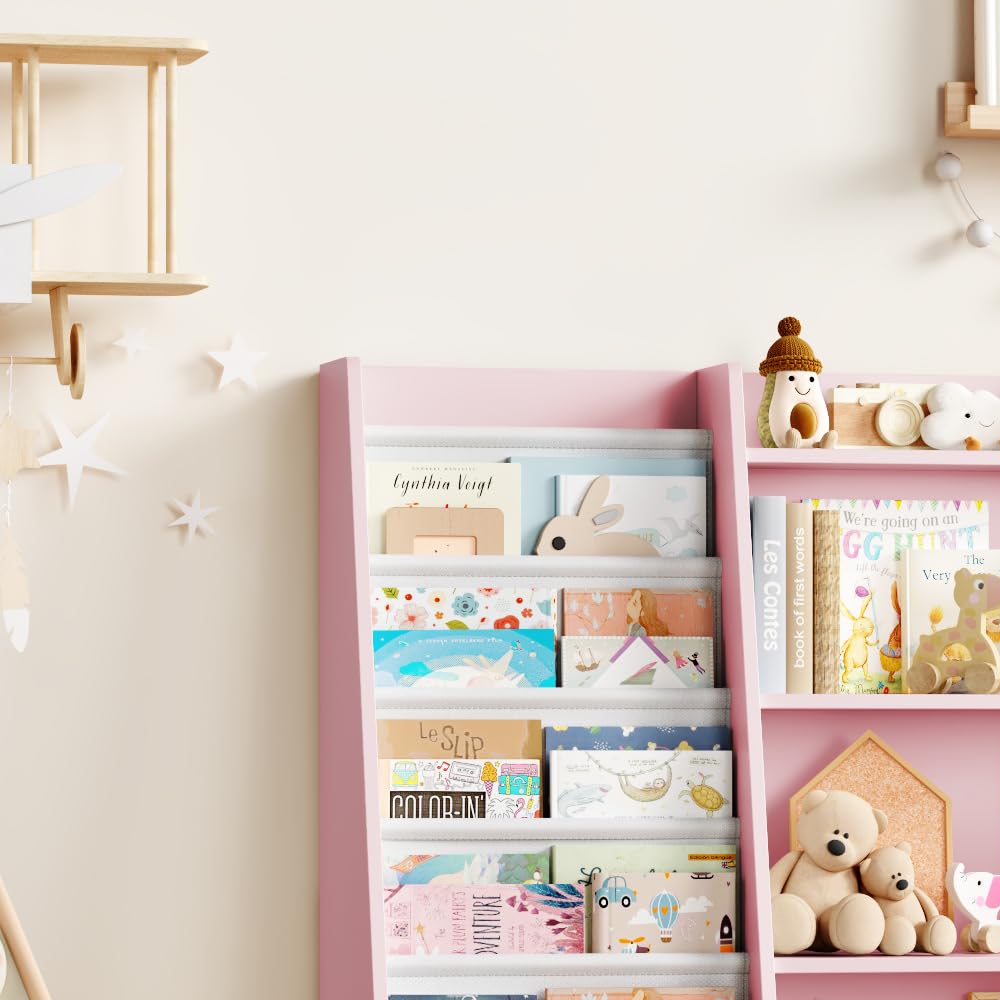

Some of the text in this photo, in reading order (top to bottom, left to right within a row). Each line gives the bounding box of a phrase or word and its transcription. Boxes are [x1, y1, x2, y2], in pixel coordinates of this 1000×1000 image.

[393, 473, 451, 497] Cynthia
[843, 510, 959, 532] We're going on an
[839, 527, 884, 561] GG
[963, 554, 985, 565] The
[922, 569, 952, 585] Very
[763, 539, 782, 651] Les Contes
[793, 527, 806, 668] book of first words
[419, 721, 438, 743] Le
